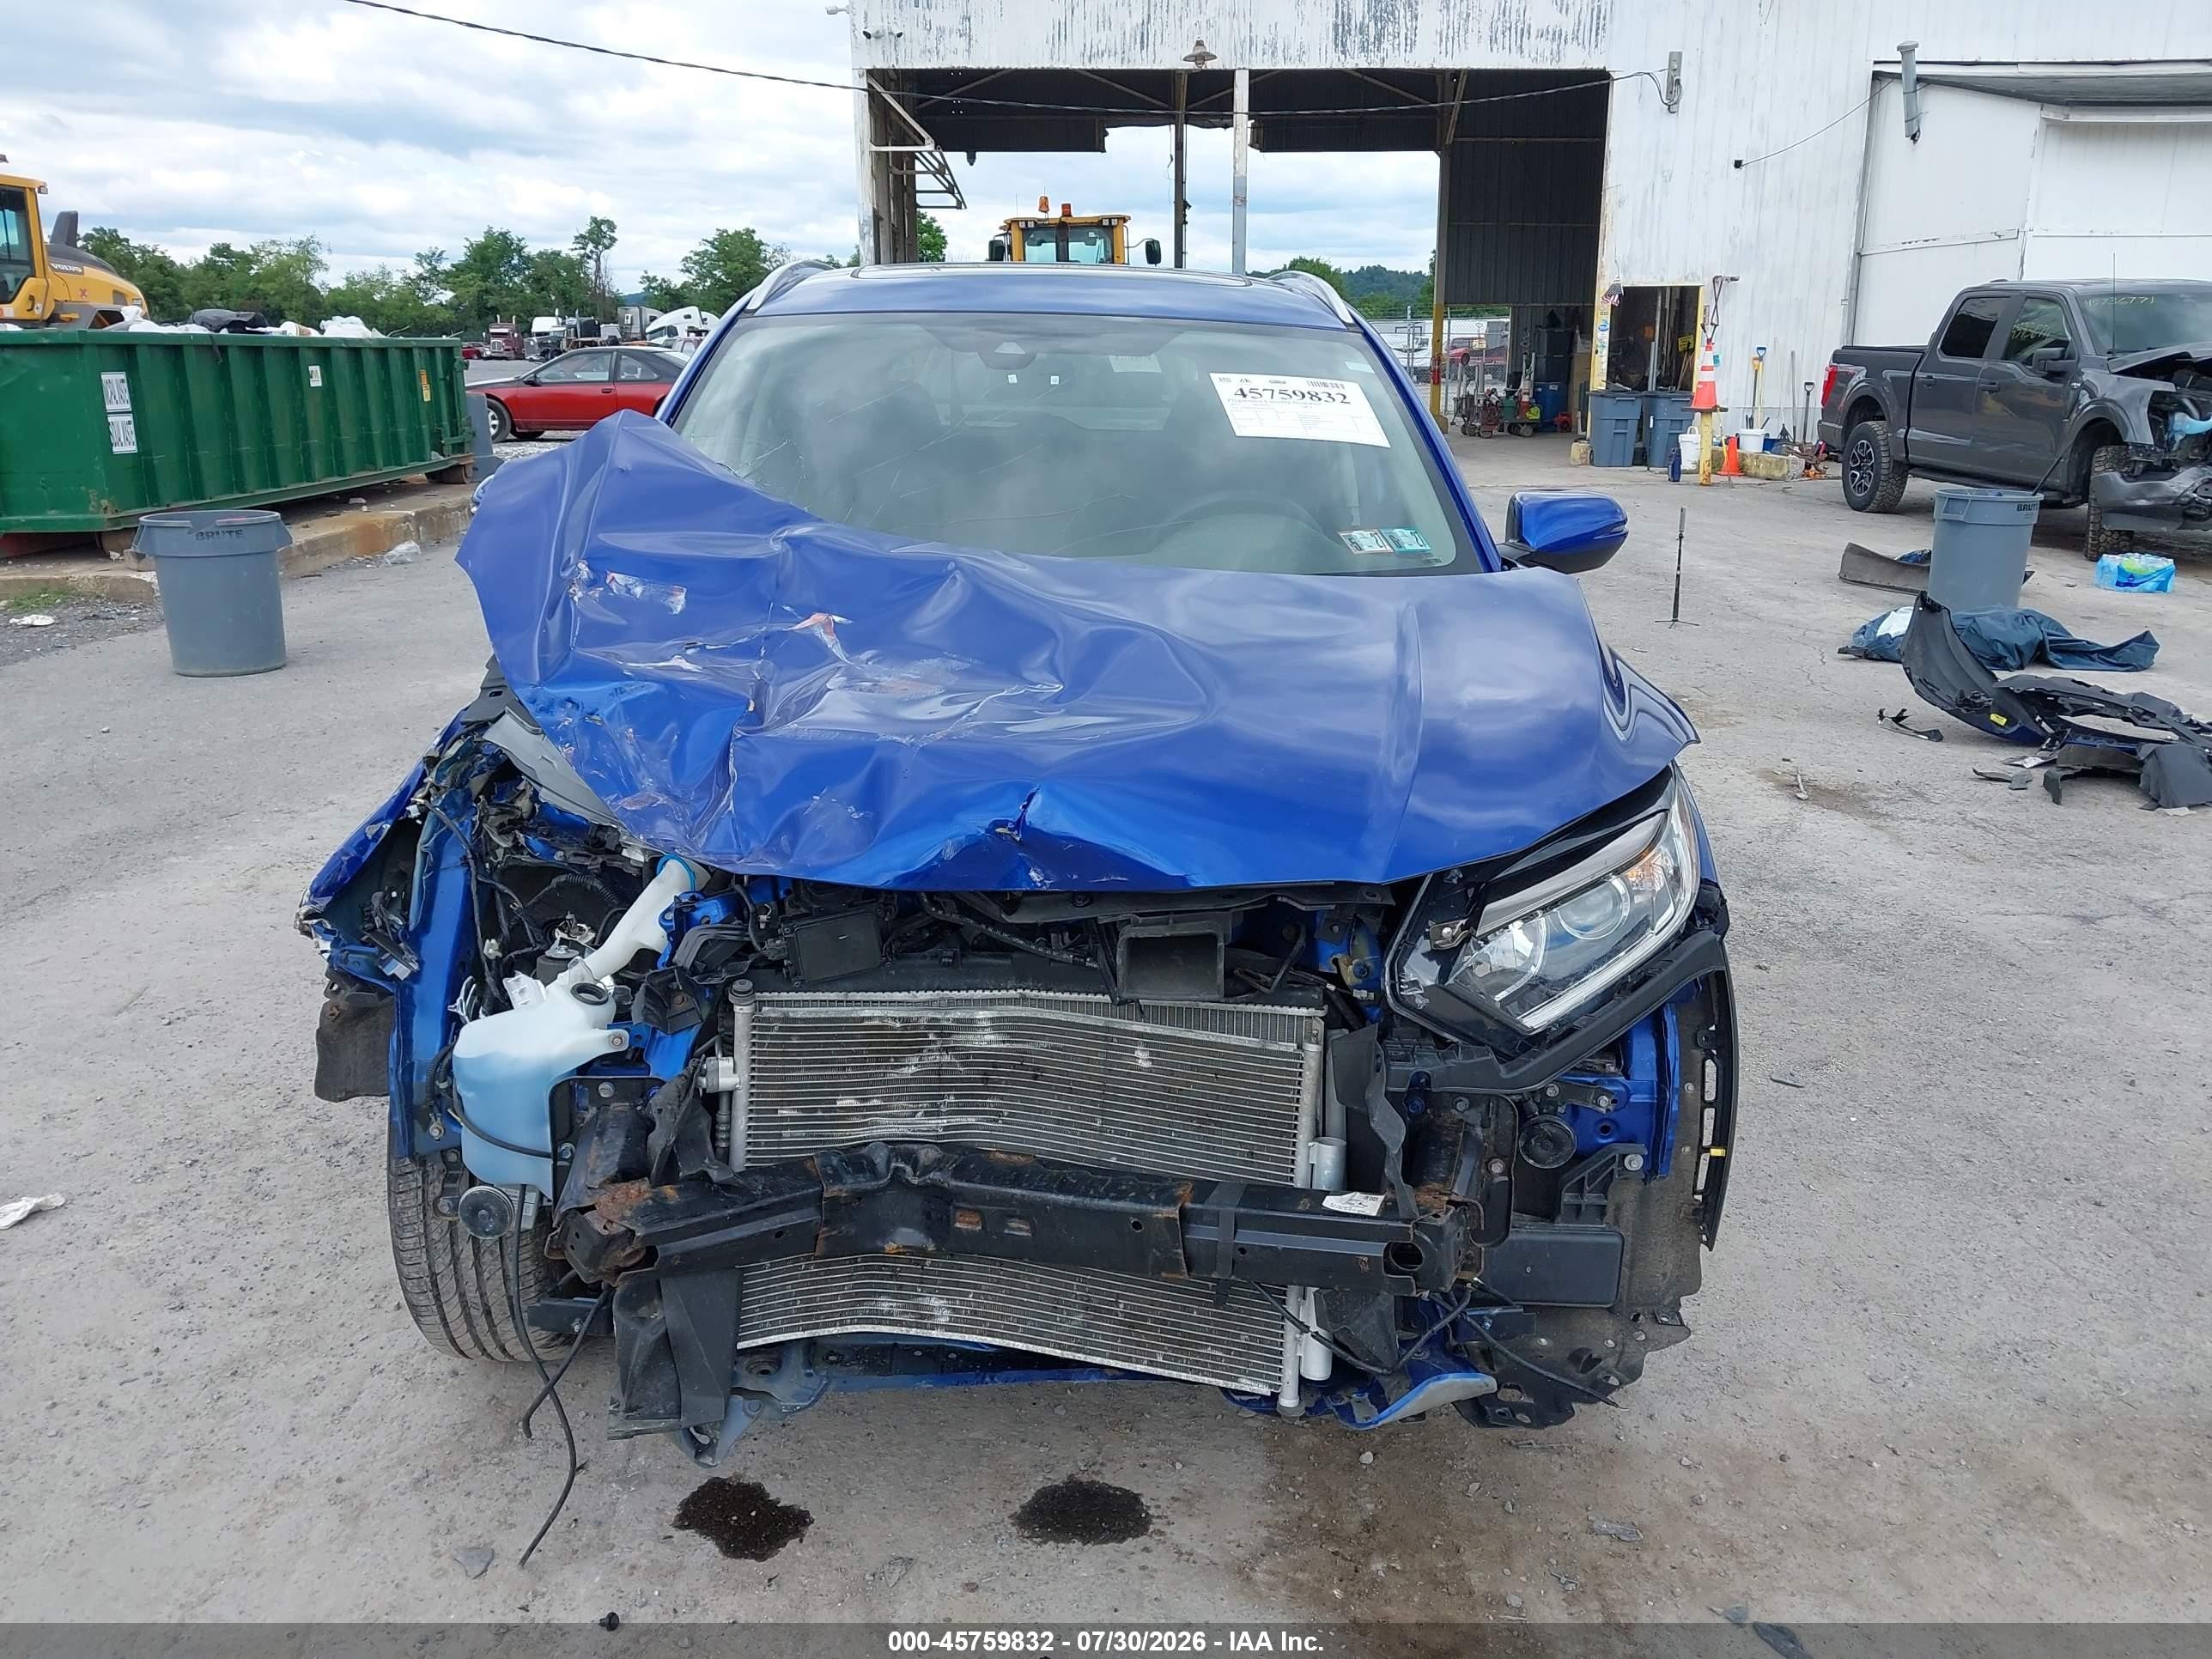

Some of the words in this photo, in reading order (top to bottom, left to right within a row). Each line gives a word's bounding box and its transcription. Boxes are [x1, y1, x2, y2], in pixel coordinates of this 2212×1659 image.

[50, 263, 82, 273] VOLVO
[1234, 387, 1352, 404] 45759832
[196, 529, 244, 541] BRUTE
